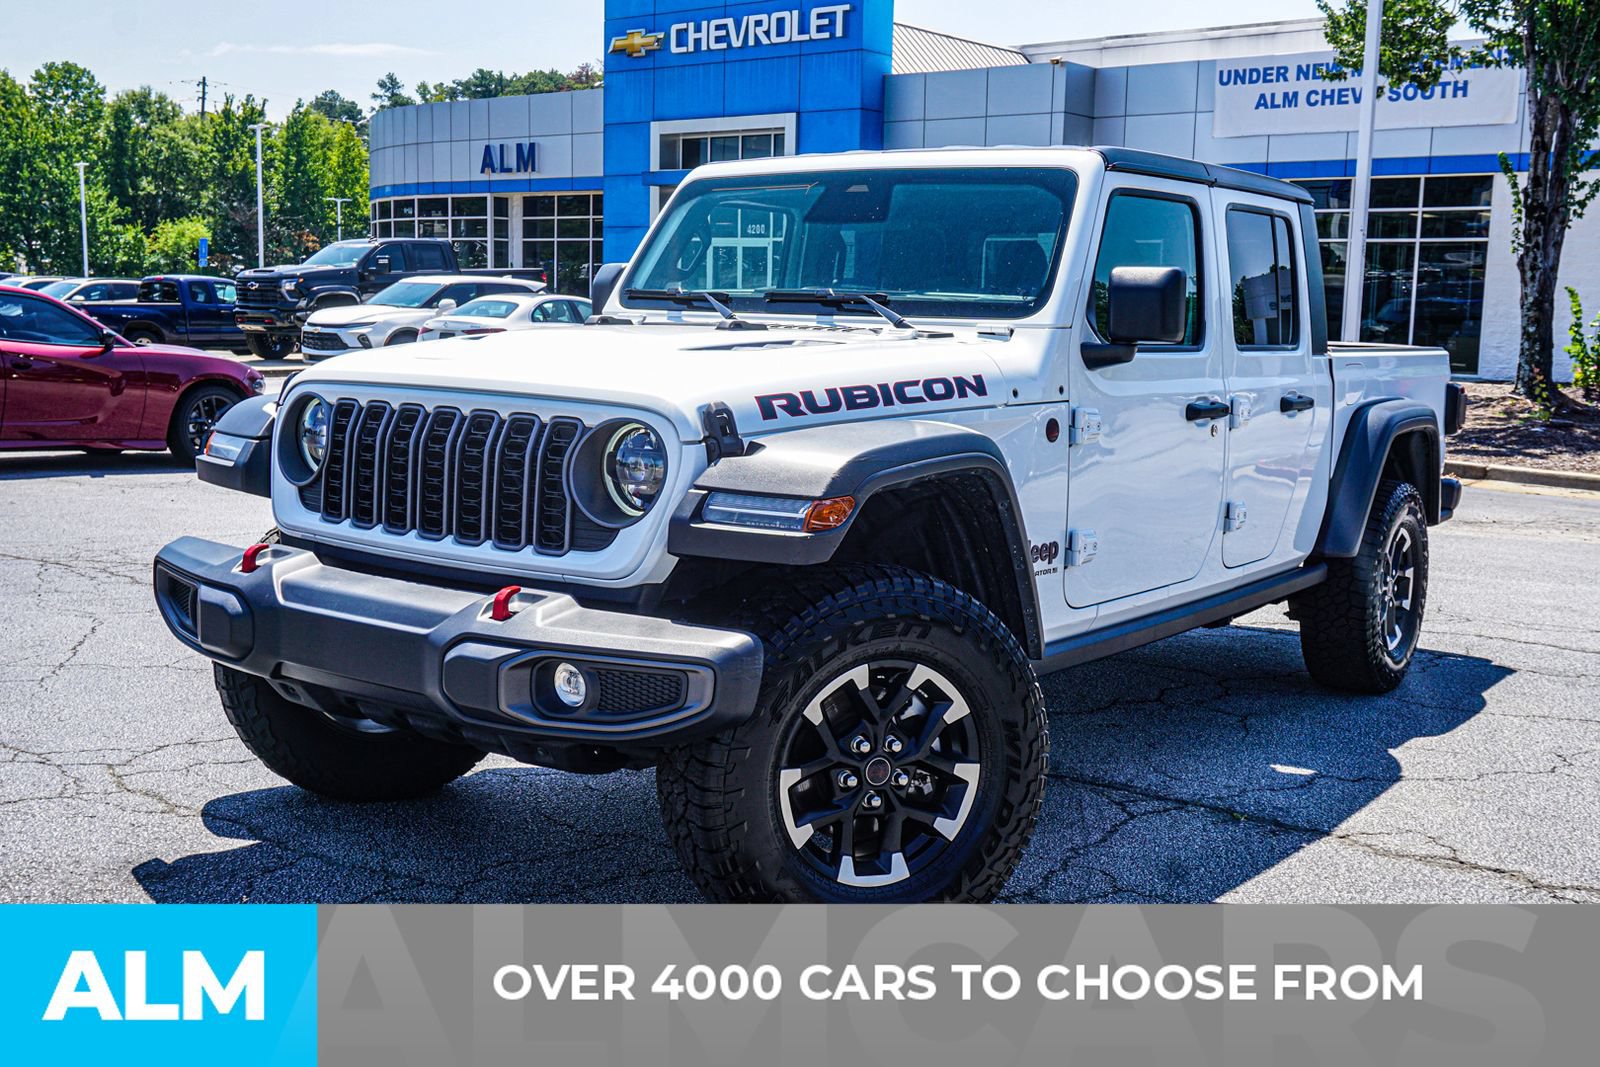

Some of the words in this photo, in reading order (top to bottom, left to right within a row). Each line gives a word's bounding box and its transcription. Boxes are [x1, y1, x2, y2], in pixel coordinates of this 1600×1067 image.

[671, 4, 850, 54] CHEVROLET
[1219, 66, 1288, 86] UNDER
[1255, 91, 1298, 109] ALM
[1306, 88, 1363, 107] CHEV
[1388, 80, 1468, 101] SOUTH
[480, 142, 536, 174] ALM
[754, 374, 988, 421] RUBICON
[1029, 540, 1059, 565] eep
